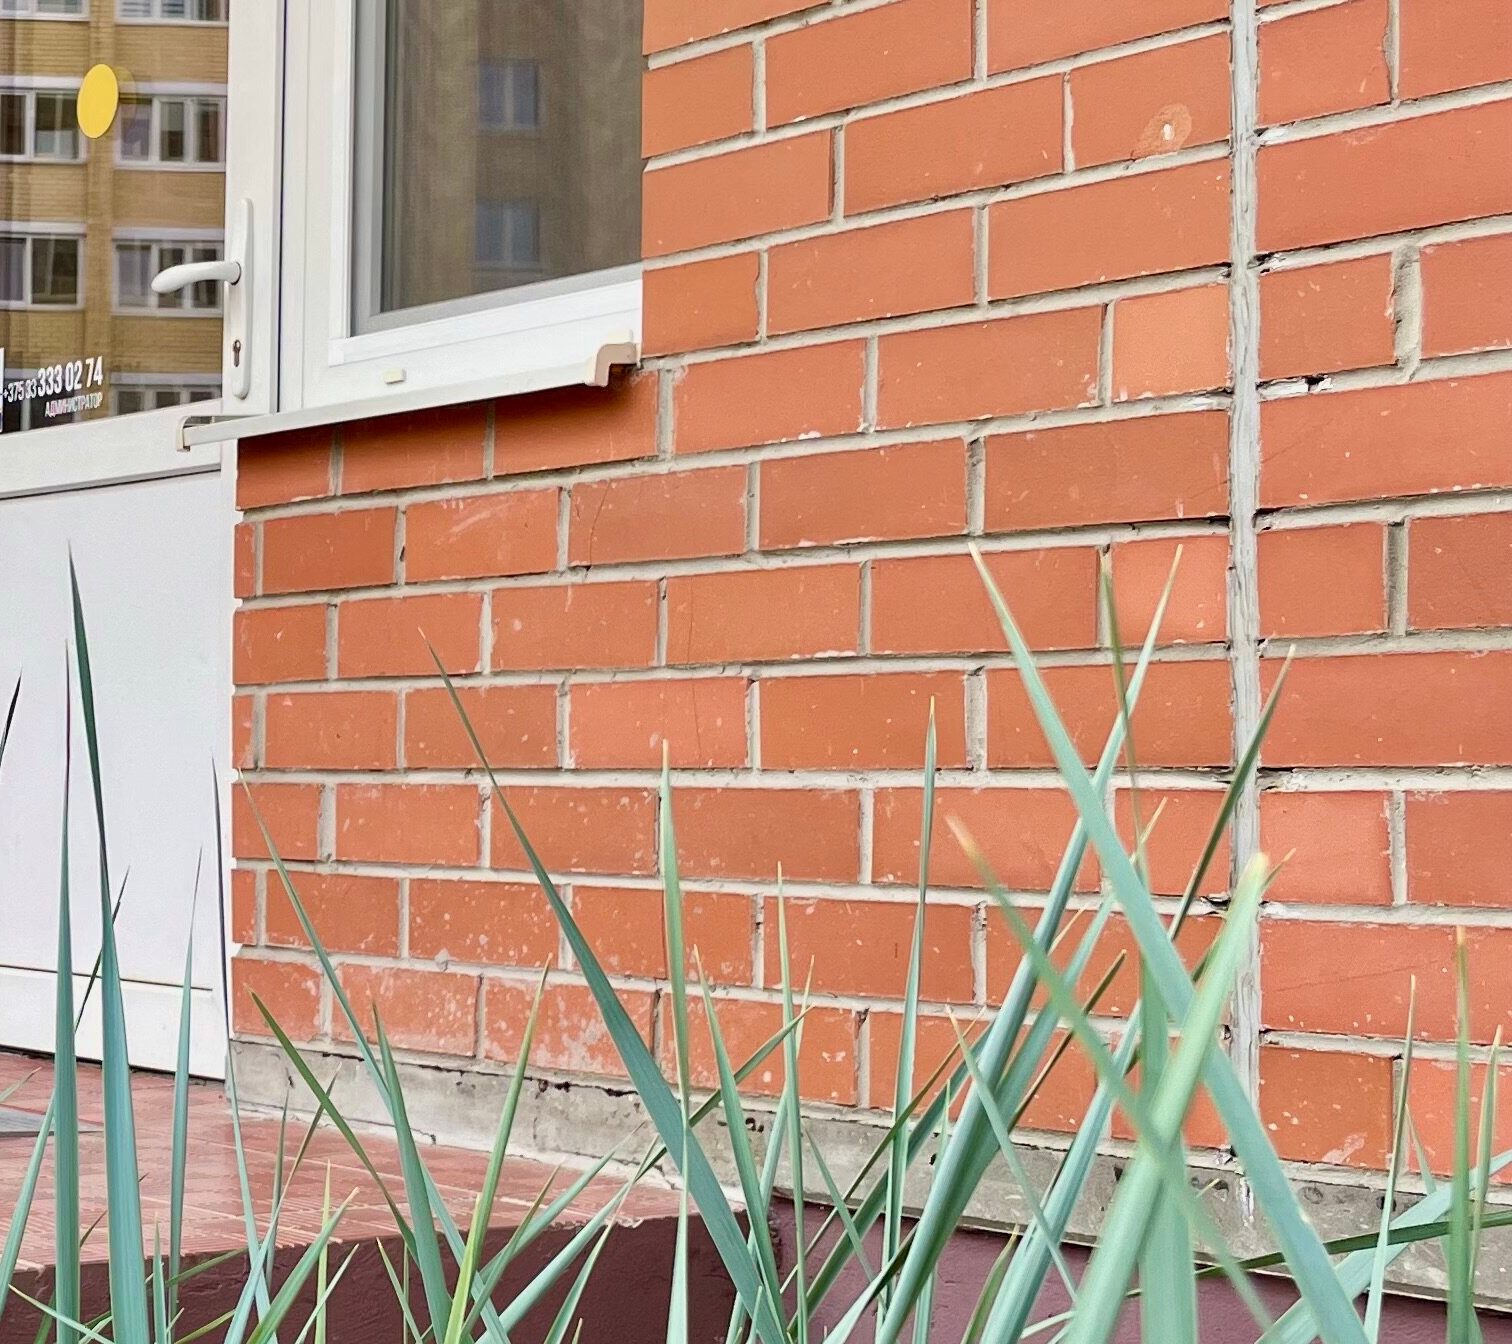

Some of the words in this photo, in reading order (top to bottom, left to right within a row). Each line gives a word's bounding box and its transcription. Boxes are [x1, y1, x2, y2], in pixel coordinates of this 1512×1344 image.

[3, 382, 24, 402] +375
[38, 365, 62, 396] 333
[65, 360, 83, 391] 02
[85, 356, 103, 387] 74
[45, 392, 103, 418] АДМИНИСТРАТОР
